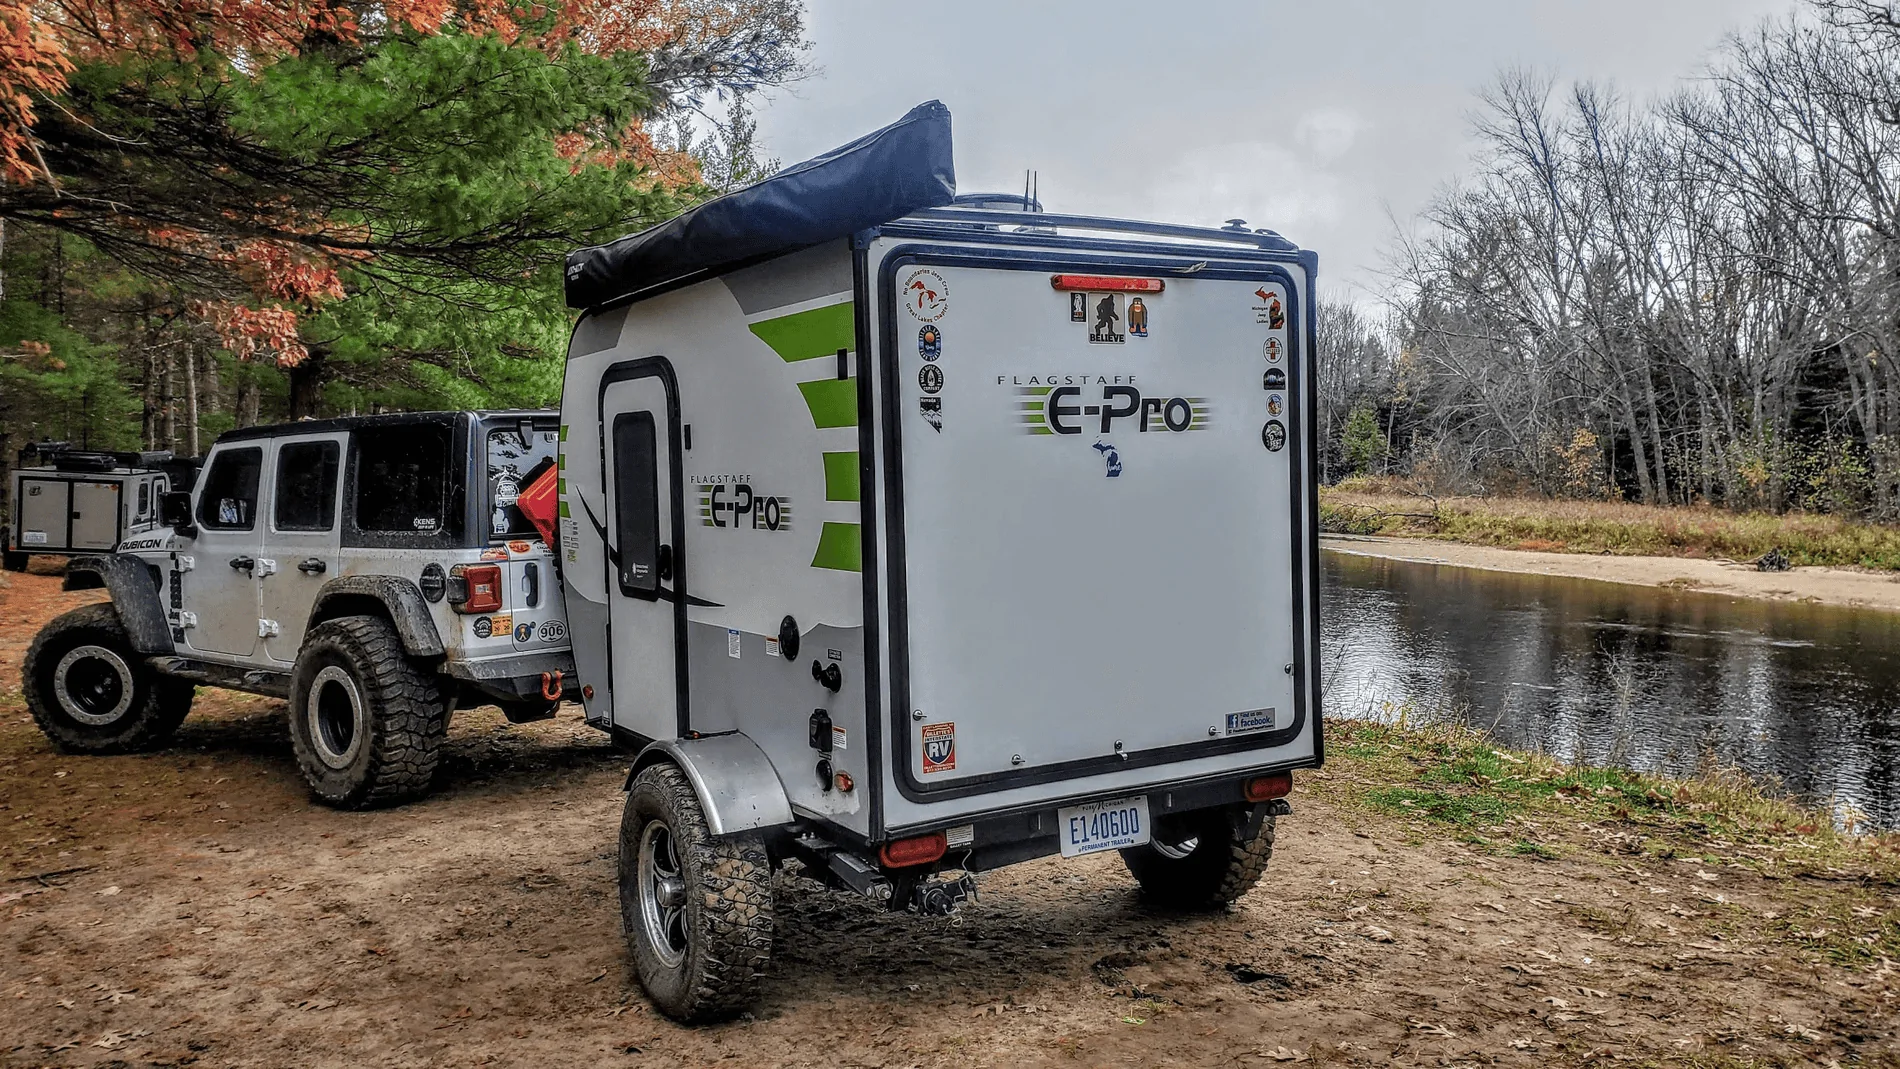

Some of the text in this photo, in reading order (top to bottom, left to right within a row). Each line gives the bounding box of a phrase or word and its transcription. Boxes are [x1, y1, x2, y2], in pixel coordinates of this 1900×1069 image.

[931, 270, 943, 281] Jeep
[941, 280, 950, 296] Crew
[906, 302, 949, 323] Great Lakes Chapter
[1090, 333, 1125, 343] BELIEVE
[997, 375, 1137, 385] FLAGSTAFF
[1049, 386, 1192, 434] E-Pro
[690, 474, 751, 484] FLAGSTAFF
[711, 484, 781, 531] E-Pro
[120, 539, 162, 550] RUBICON
[540, 626, 563, 638] 906
[1241, 716, 1271, 727] facebook
[928, 741, 950, 758] RV
[1093, 801, 1124, 813] MICHIGAN
[1070, 808, 1139, 845] E140600
[1081, 838, 1131, 851] PERMANENT TRAILER
